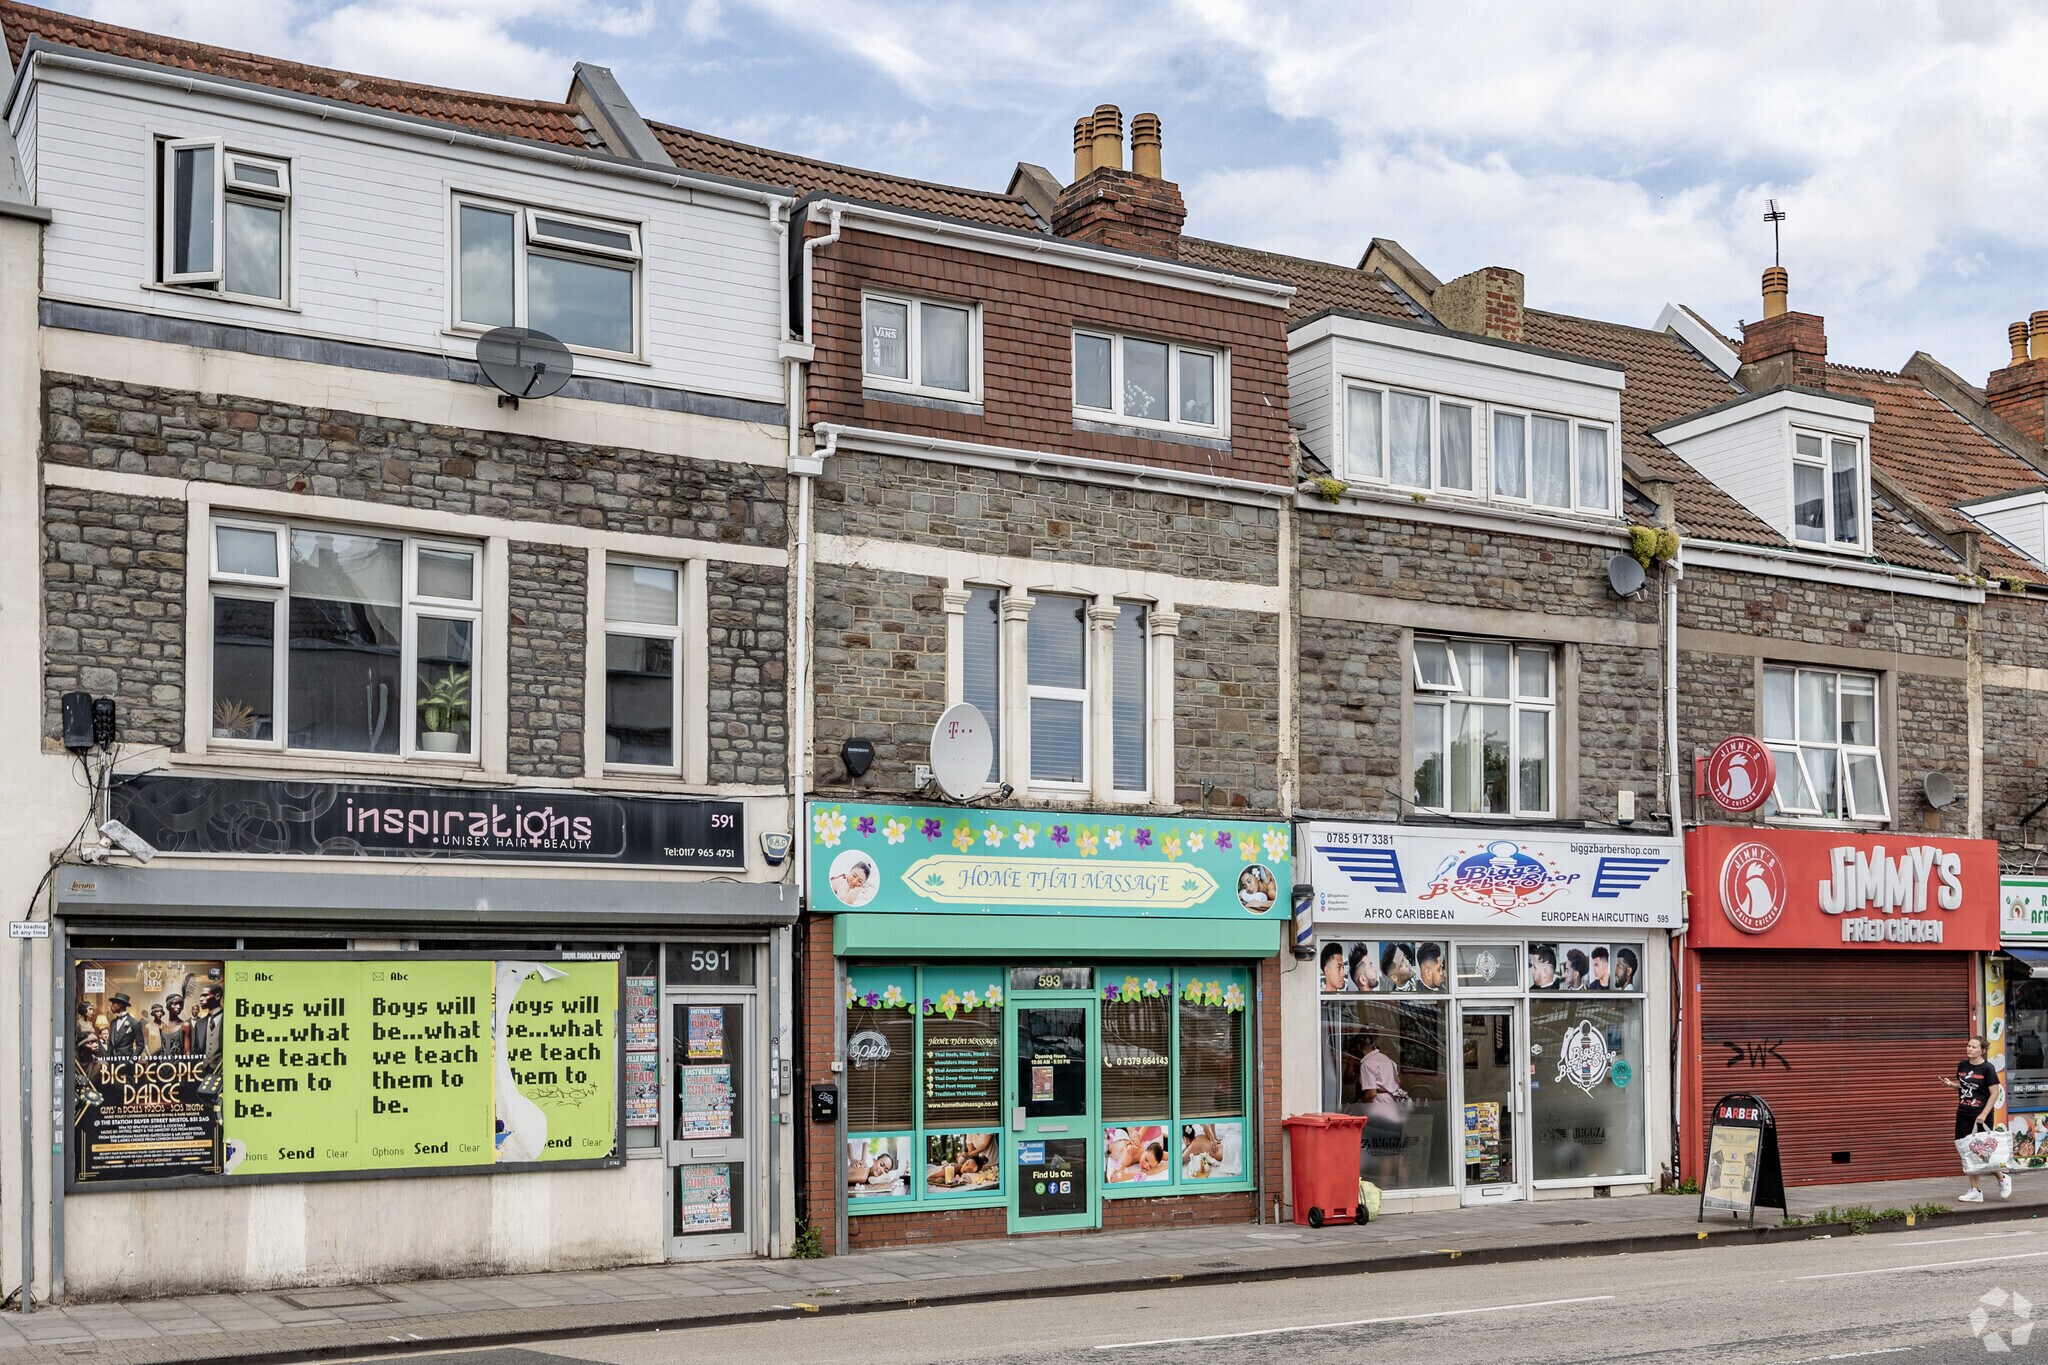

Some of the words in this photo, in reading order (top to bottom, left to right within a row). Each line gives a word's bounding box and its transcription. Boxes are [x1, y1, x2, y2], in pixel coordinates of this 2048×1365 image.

[873, 326, 897, 339] VANS
[872, 337, 880, 367] OFF
[1731, 791, 1757, 808] CHICKEN
[346, 797, 592, 844] inspirations
[711, 814, 734, 828] 591
[442, 835, 490, 847] UNISEX
[496, 837, 528, 849] HAIR
[544, 839, 592, 850] BEAUTY
[1326, 832, 1350, 844] 0785
[1352, 833, 1369, 845] 917
[1372, 834, 1394, 845] 3381
[664, 847, 695, 857] Tel:0117
[697, 849, 714, 858] 965
[716, 849, 735, 858] 4751
[1570, 842, 1660, 857] biggzbarbershop.com
[957, 864, 1022, 890] HOME
[1026, 867, 1078, 892] THAI
[1081, 870, 1170, 899] MASSAGE
[1453, 864, 1541, 885] Biggz
[1364, 908, 1393, 919] AFRO
[1396, 908, 1455, 920] CARIBBEAN
[1541, 911, 1590, 922] EUROPEAN
[1592, 912, 1649, 923] HAIRCUTTING
[1657, 914, 1670, 923] 595
[1754, 905, 1779, 927] CHICKEN
[1842, 916, 1885, 942] FRiED
[1885, 917, 1943, 943] CHiCKEN
[562, 952, 621, 960] BUILDHOLLYWOOD
[690, 949, 730, 971] 591
[255, 972, 274, 981] Abc
[390, 972, 409, 981] Abc
[1038, 974, 1061, 987] 593
[235, 998, 294, 1019] Boys
[303, 997, 345, 1017] will
[373, 997, 428, 1018] Boys
[437, 996, 475, 1015] will
[509, 1000, 554, 1016] oys
[562, 996, 599, 1014] will
[235, 1022, 350, 1042] be...what
[373, 1020, 480, 1040] be...what
[928, 1037, 949, 1046] HOME
[950, 1036, 967, 1046] THAI
[968, 1036, 998, 1047] MASSAGE
[235, 1053, 270, 1067] we
[280, 1047, 347, 1067] teach
[373, 1050, 406, 1065] we
[415, 1044, 478, 1063] teach
[540, 1043, 601, 1060] teach
[1568, 1043, 1604, 1066] Biggz
[1116, 1057, 1122, 1066] 0
[1123, 1057, 1141, 1066] 7379
[1142, 1056, 1169, 1065] 664143
[100, 1063, 127, 1085] BIG
[133, 1061, 204, 1083] PEOPLE
[373, 1070, 433, 1089] them
[442, 1069, 464, 1087] to
[510, 1067, 557, 1085] hem
[566, 1066, 587, 1084] to
[633, 1071, 655, 1083] FAIR
[685, 1068, 712, 1076] EASTVILLE
[712, 1067, 728, 1075] PARK
[235, 1073, 298, 1093] them
[308, 1072, 331, 1091] to
[686, 1084, 705, 1096] FUN
[705, 1083, 728, 1096] FAIR
[123, 1083, 181, 1105] DANCE
[123, 1104, 143, 1114] DOLLS
[234, 1099, 272, 1118] be.
[373, 1095, 409, 1114] be.
[1719, 1106, 1759, 1121] BARBER
[372, 1147, 405, 1158] Options
[414, 1141, 448, 1154] Send
[459, 1143, 480, 1152] Clear
[545, 1136, 572, 1148] end
[582, 1138, 602, 1147] Clear
[244, 1152, 268, 1161] tions
[279, 1146, 315, 1160] Send
[326, 1148, 349, 1158] Clear
[685, 1177, 704, 1189] FUN
[705, 1176, 727, 1187] FAIR
[1032, 1171, 1049, 1179] Find
[1049, 1170, 1060, 1178] Us
[1060, 1170, 1073, 1178] On:
